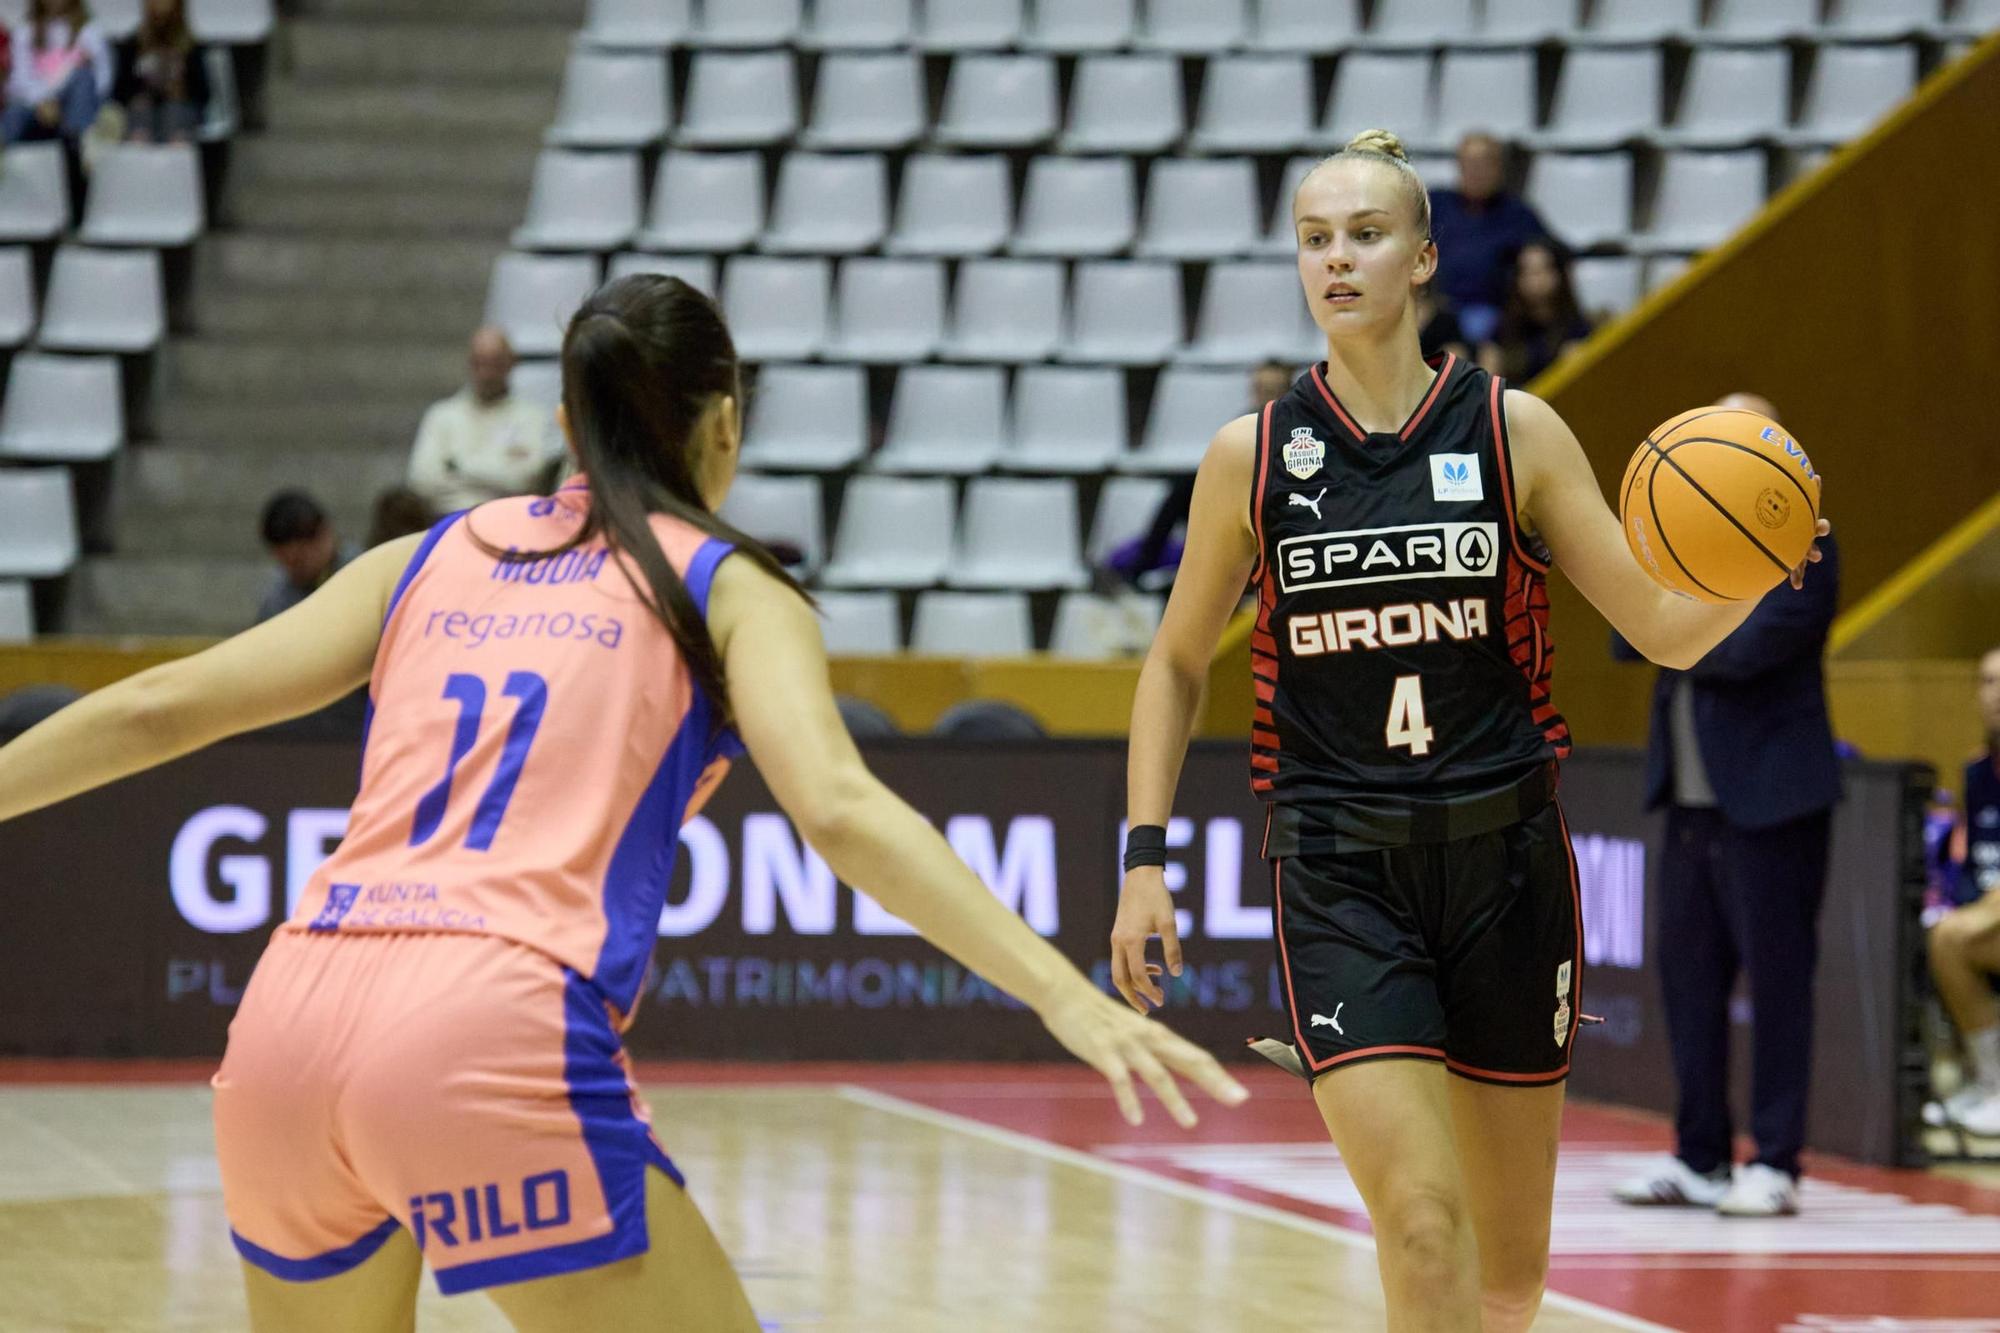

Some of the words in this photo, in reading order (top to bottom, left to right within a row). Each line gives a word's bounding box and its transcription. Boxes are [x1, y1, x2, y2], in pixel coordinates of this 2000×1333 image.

[1287, 457, 1322, 470] GIRONA
[1288, 535, 1443, 580] SPAR
[424, 610, 624, 649] reganosa
[1288, 599, 1488, 656] GIRONA
[1385, 674, 1434, 756] 4
[383, 906, 486, 928] GALICIA
